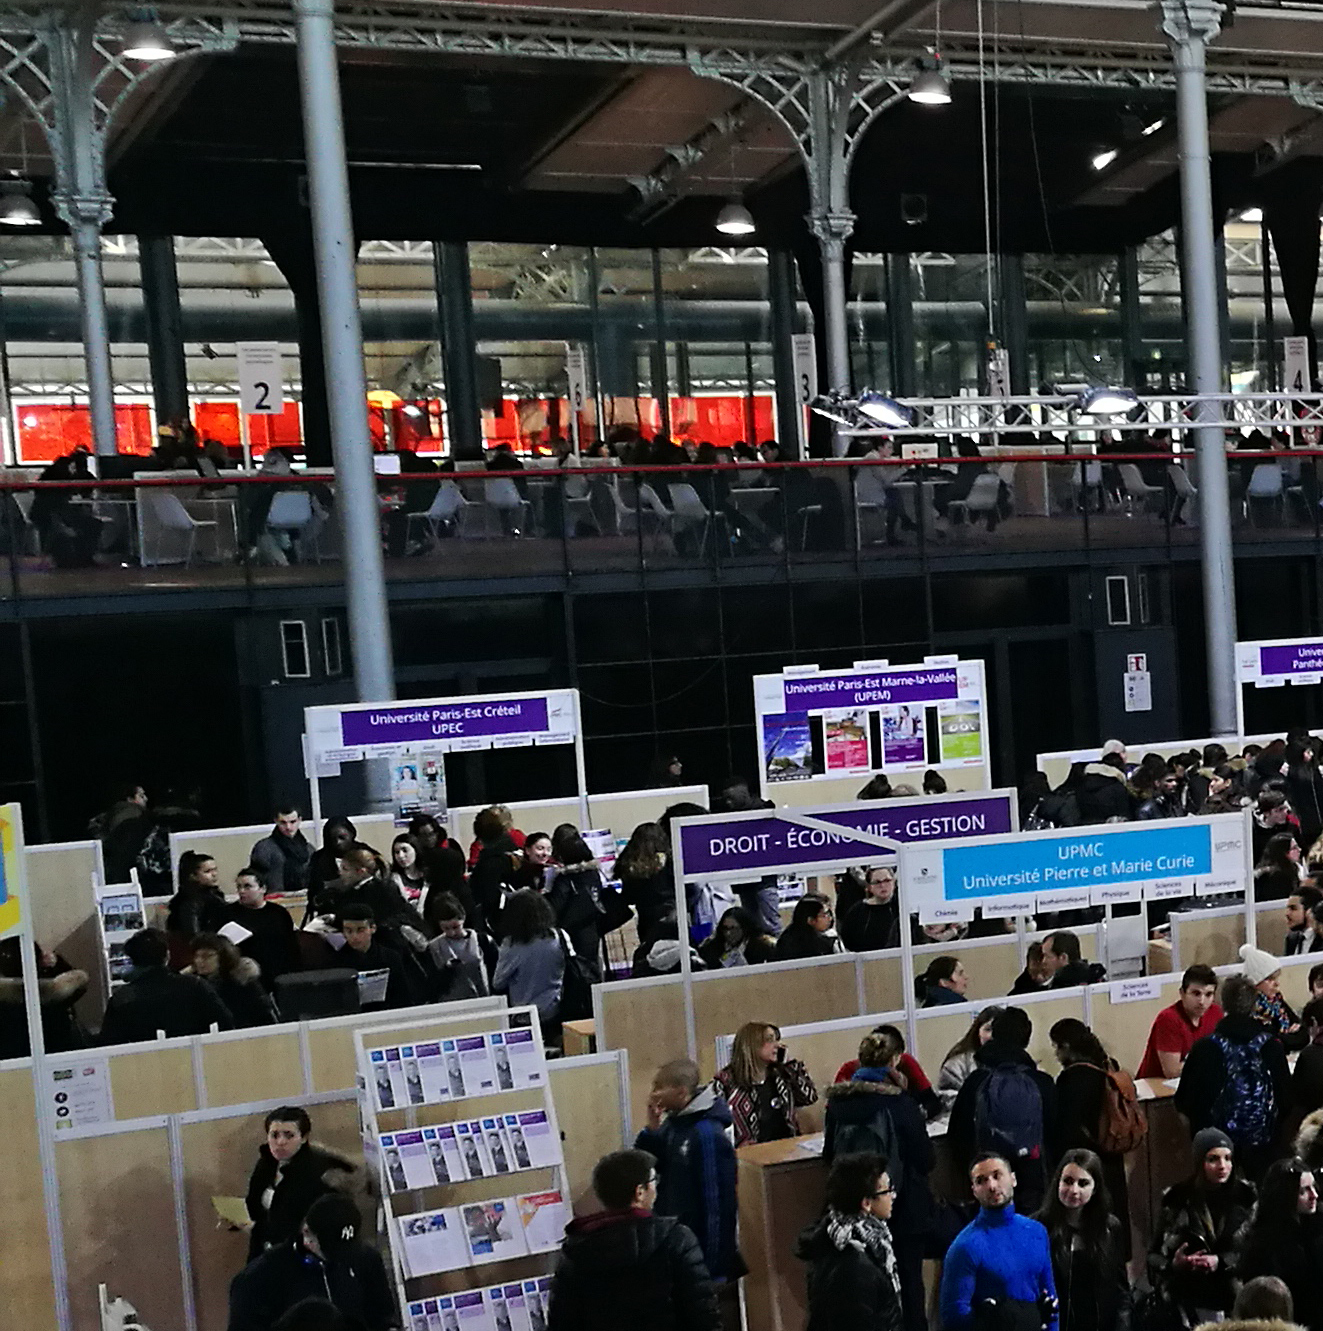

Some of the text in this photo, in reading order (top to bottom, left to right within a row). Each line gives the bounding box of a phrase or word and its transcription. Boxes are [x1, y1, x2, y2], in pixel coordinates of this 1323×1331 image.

[801, 373, 810, 402] 3
[1293, 369, 1303, 392] 4
[254, 382, 271, 410] 2
[785, 672, 956, 694] Université Paris-Est Marne-la-Vallée
[854, 690, 892, 703] (UPEM)
[370, 704, 522, 726] Université Paris-Est Créteil
[432, 722, 464, 735] UPEC
[709, 834, 770, 857] DROIT
[905, 813, 986, 838] GESTION
[1058, 842, 1104, 860] UPMC
[963, 854, 1195, 890] Université Pierre et Marie Curie
